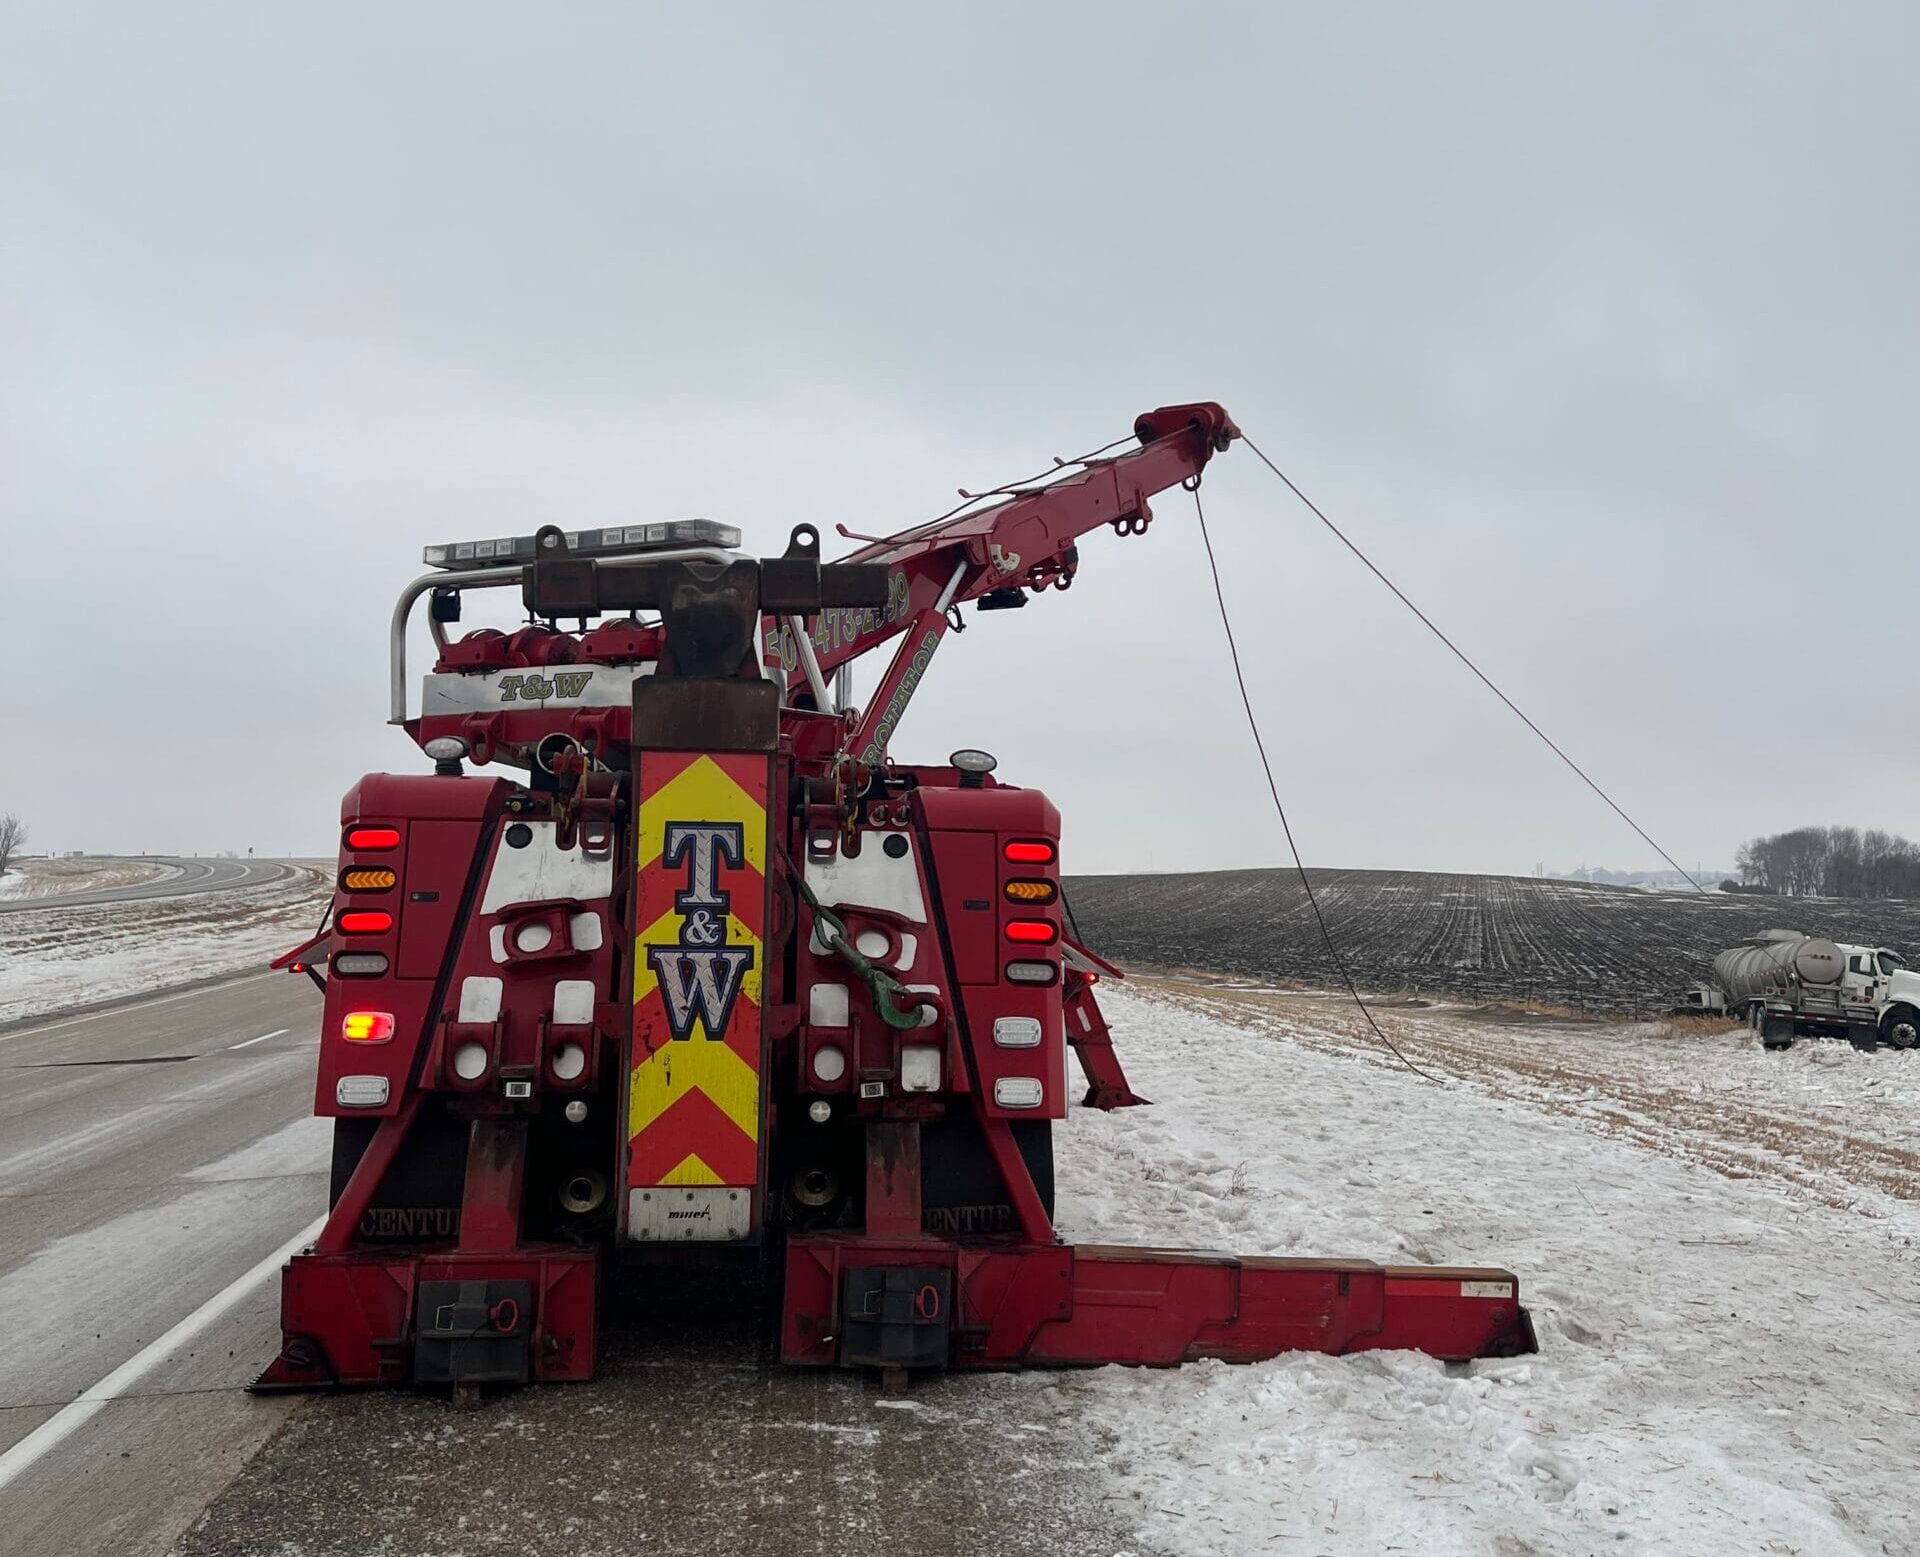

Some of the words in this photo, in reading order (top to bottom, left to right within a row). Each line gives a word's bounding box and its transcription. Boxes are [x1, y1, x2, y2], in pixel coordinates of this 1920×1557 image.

[498, 672, 593, 701] T&W
[857, 630, 939, 767] ROTATOR
[360, 1207, 460, 1236] CENTU
